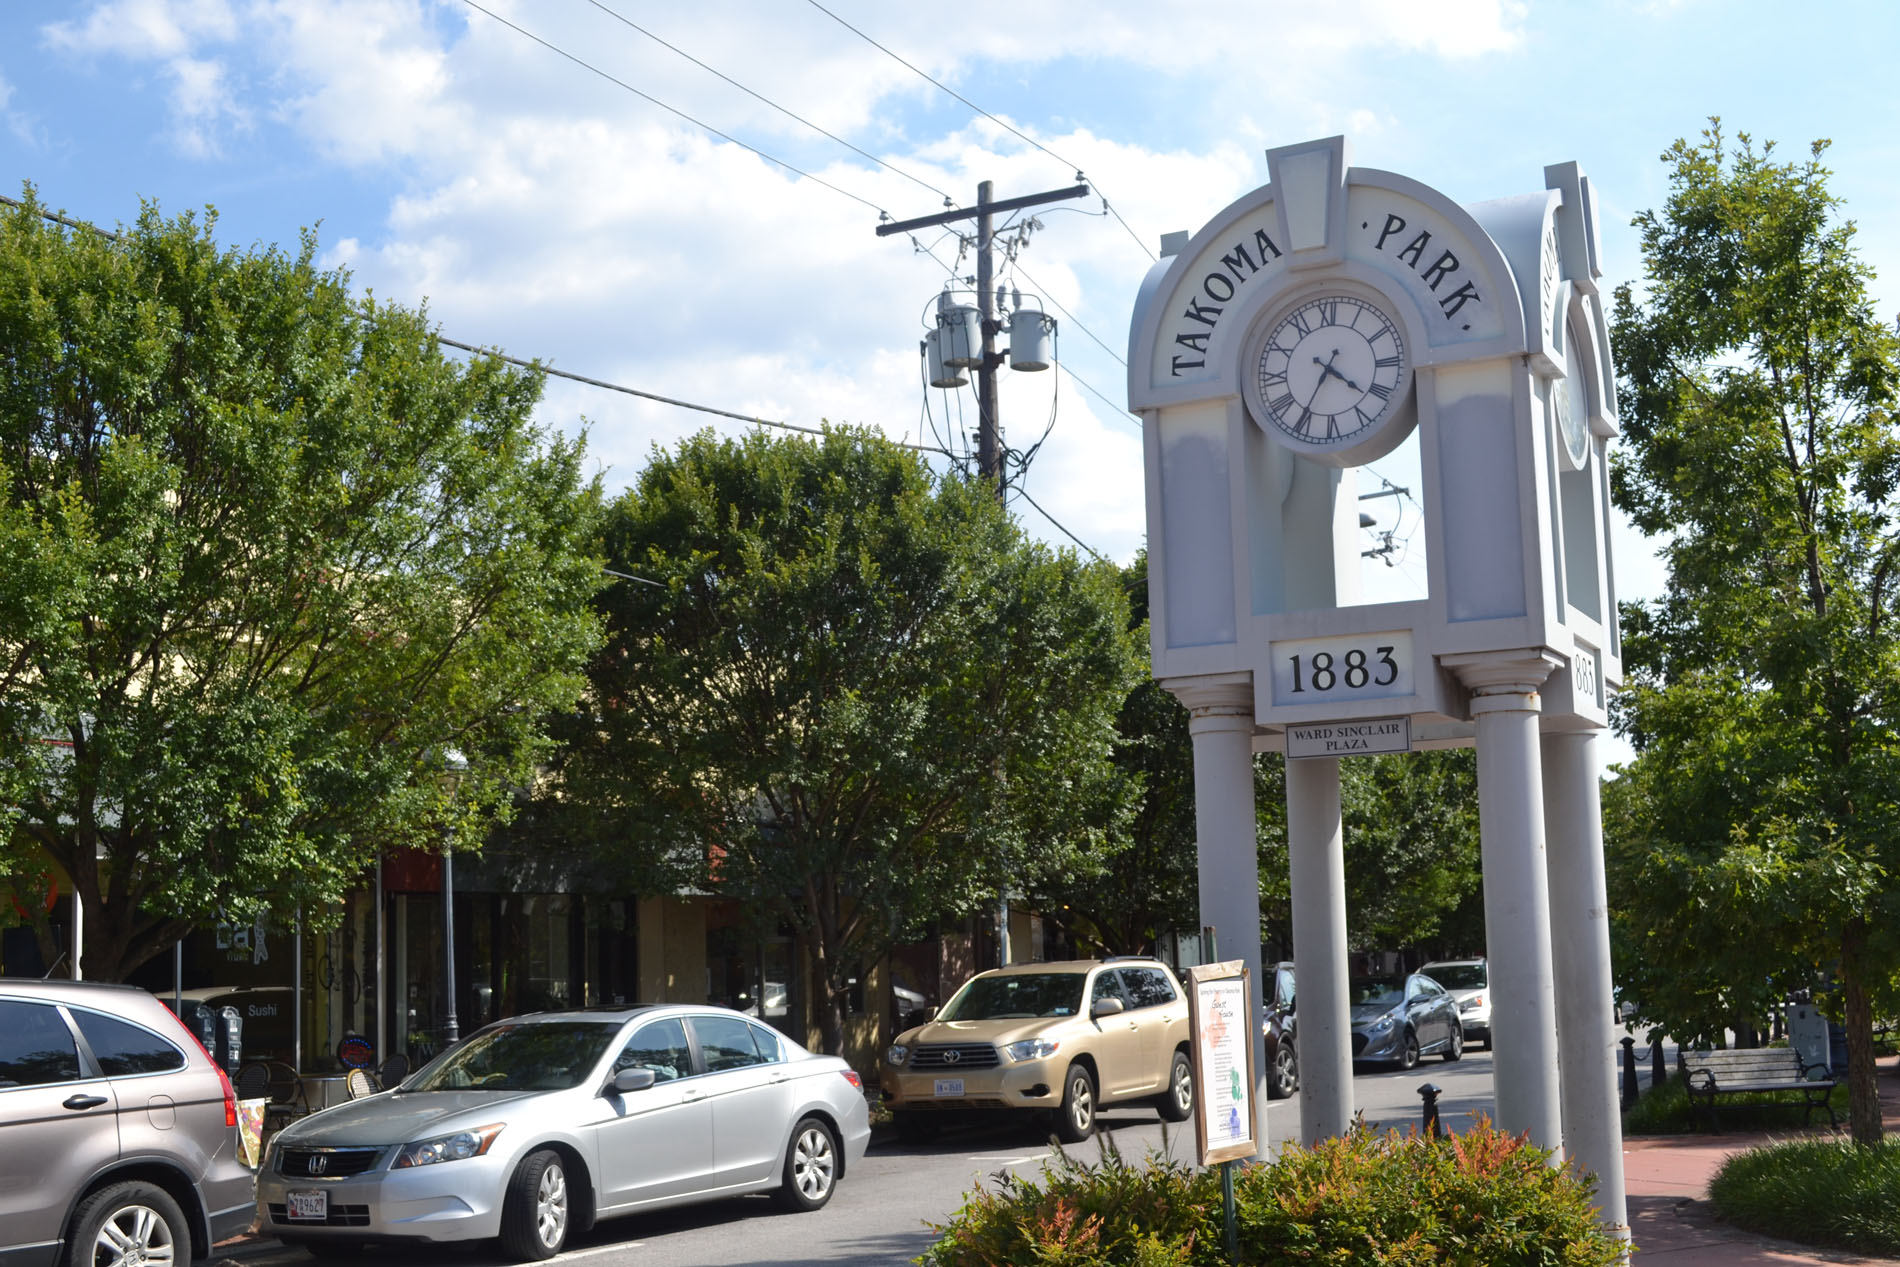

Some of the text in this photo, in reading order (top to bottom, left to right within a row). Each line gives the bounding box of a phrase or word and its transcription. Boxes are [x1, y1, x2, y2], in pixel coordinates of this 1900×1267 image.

[1171, 228, 1284, 377] TAKOMA
[1289, 646, 1399, 693] 1883
[1294, 724, 1400, 741] WARD SINCLAIR
[1326, 739, 1368, 751] PLAZA
[248, 1004, 277, 1017] Sushi
